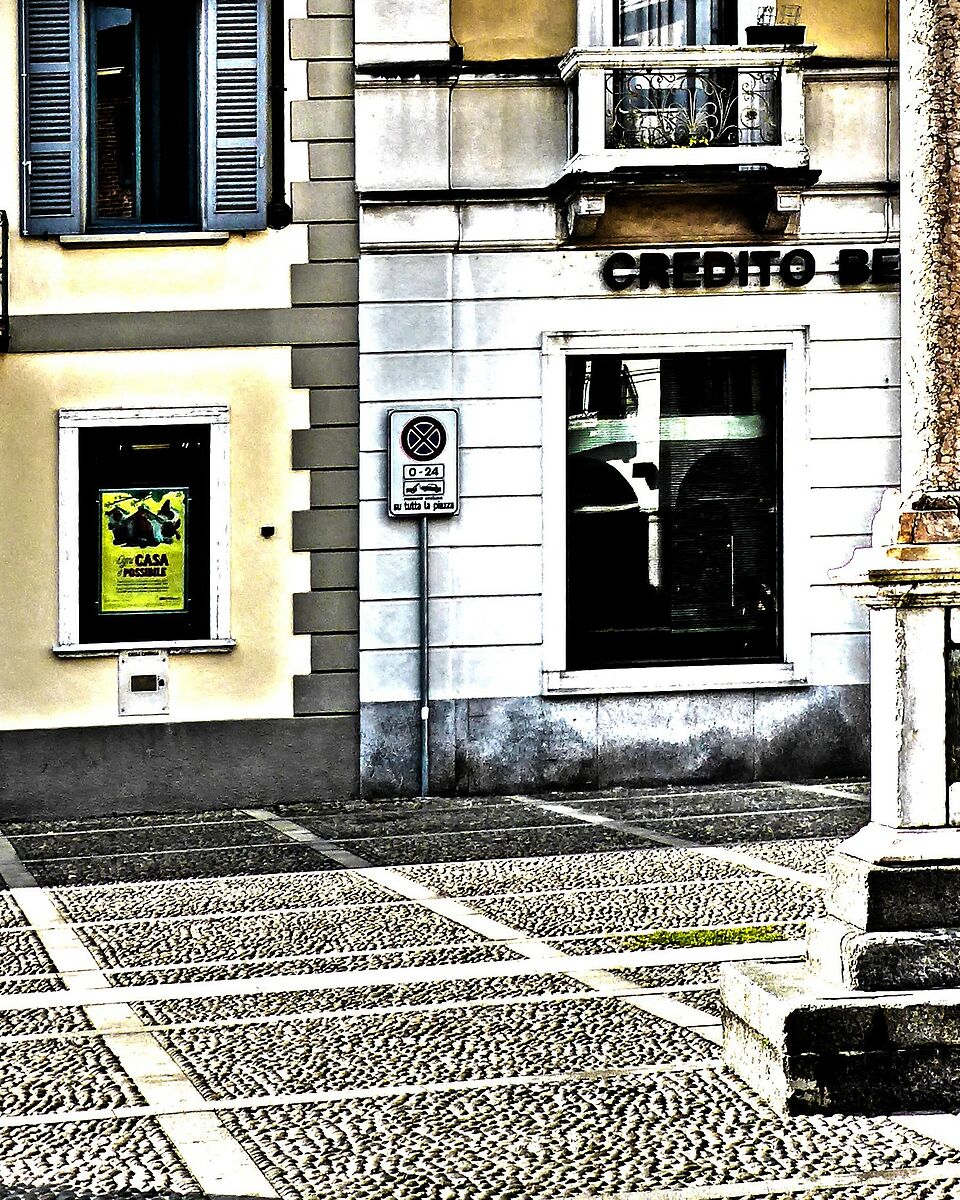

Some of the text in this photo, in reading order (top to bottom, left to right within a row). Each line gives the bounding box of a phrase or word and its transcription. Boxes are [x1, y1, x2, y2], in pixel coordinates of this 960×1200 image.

[602, 249, 816, 291] CREDITO
[404, 501, 422, 511] tutta
[424, 500, 431, 510] la
[134, 553, 169, 567] CASA
